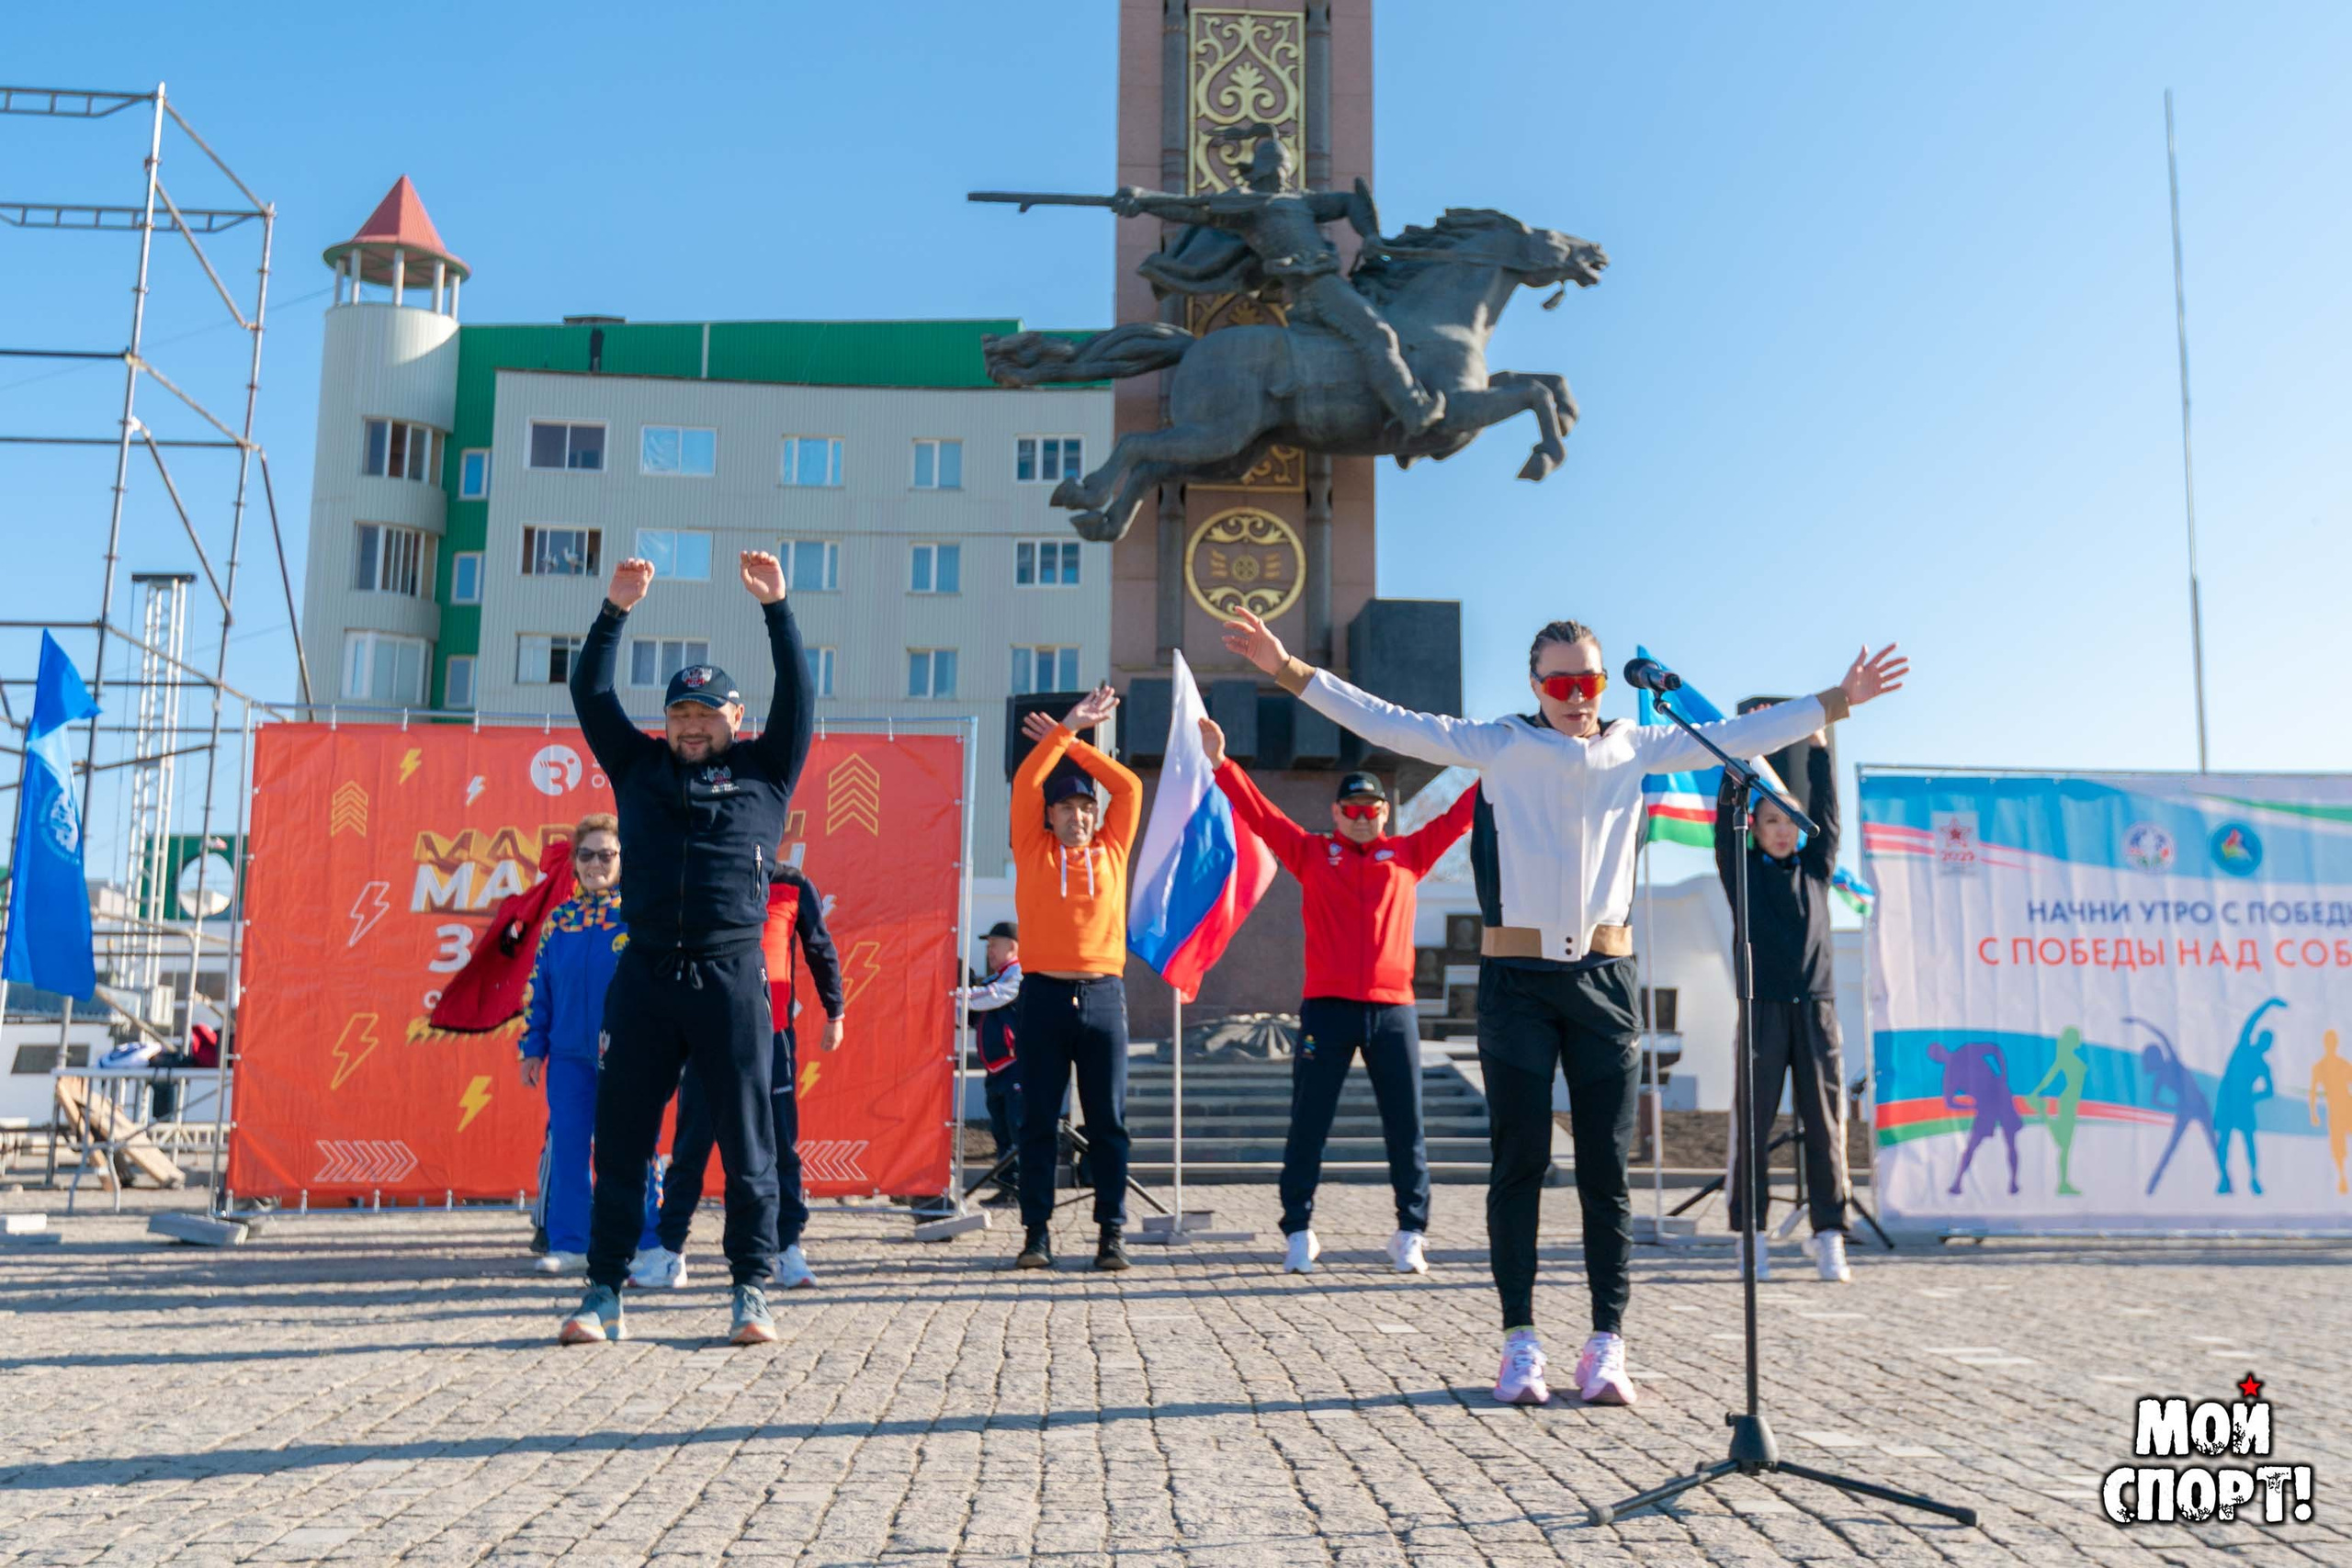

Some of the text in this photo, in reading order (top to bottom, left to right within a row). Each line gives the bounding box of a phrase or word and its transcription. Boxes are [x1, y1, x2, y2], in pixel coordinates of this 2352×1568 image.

[2027, 900, 2352, 928] НАЧНИ УТРО С ПОБЕД
[1978, 937, 2000, 965] С
[2011, 937, 2165, 972] ПОБЕДЫ
[2177, 938, 2263, 973] НАД
